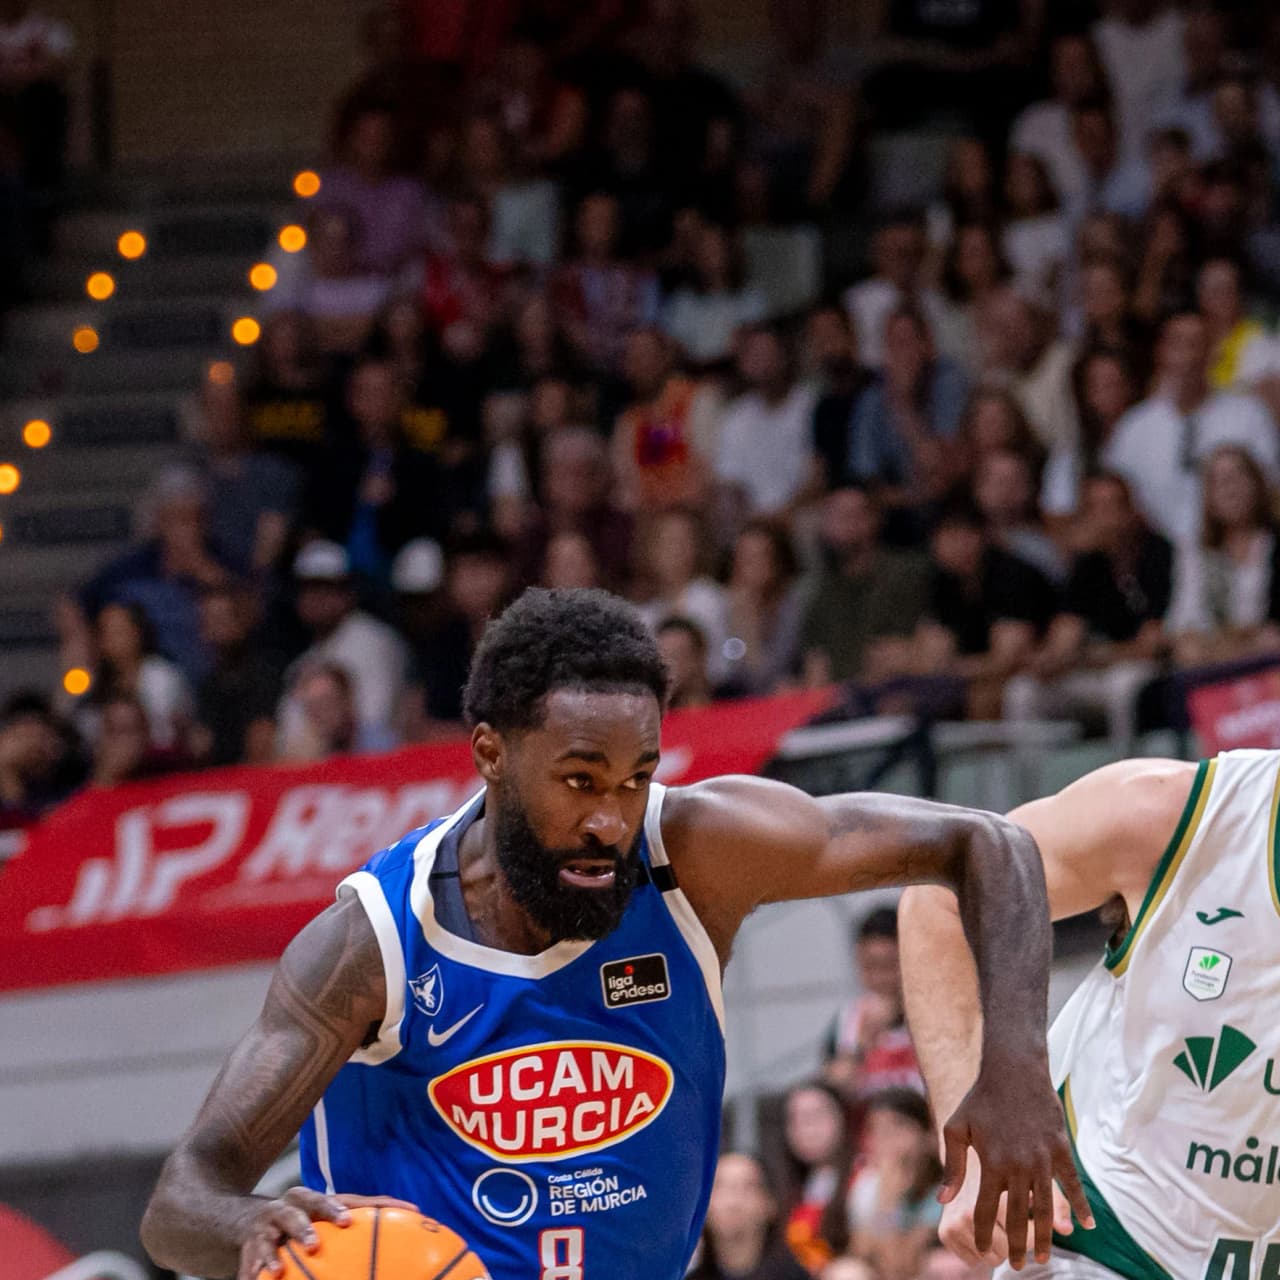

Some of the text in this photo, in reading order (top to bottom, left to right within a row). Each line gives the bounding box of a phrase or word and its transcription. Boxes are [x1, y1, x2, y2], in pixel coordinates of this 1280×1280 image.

[608, 975, 633, 990] liga
[610, 983, 665, 1002] endesa
[468, 1050, 635, 1106] UCAM
[451, 1092, 656, 1151] MURCIA
[549, 1176, 619, 1200] REGIÓN
[551, 1184, 648, 1217] DE MURCIA
